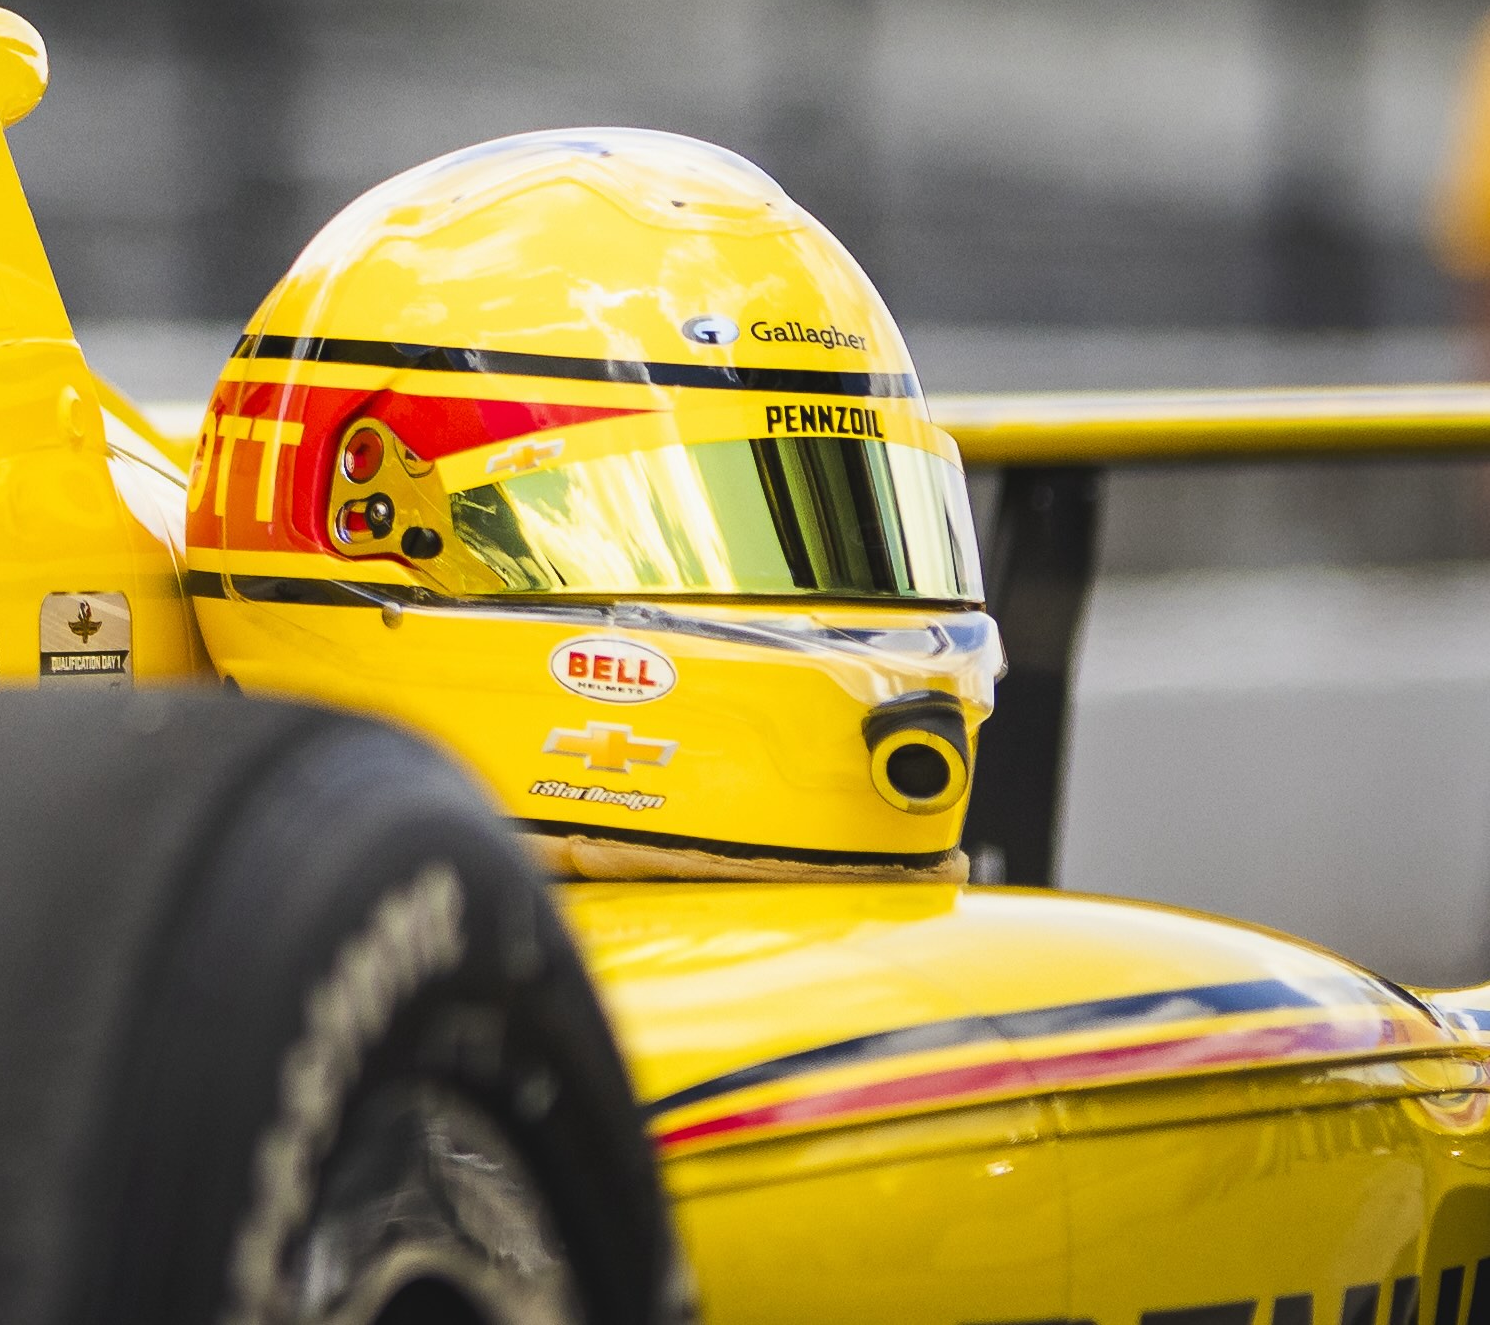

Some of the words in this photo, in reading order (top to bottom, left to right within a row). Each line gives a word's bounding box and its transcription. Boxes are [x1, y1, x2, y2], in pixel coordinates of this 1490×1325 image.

[750, 320, 868, 351] Gallagher
[765, 404, 884, 439] PENNZOIL
[188, 410, 305, 523] OTT
[50, 655, 101, 672] QUALIFICATION
[102, 654, 116, 670] DAY
[568, 650, 658, 688] BELL
[577, 680, 645, 696] HELMETS
